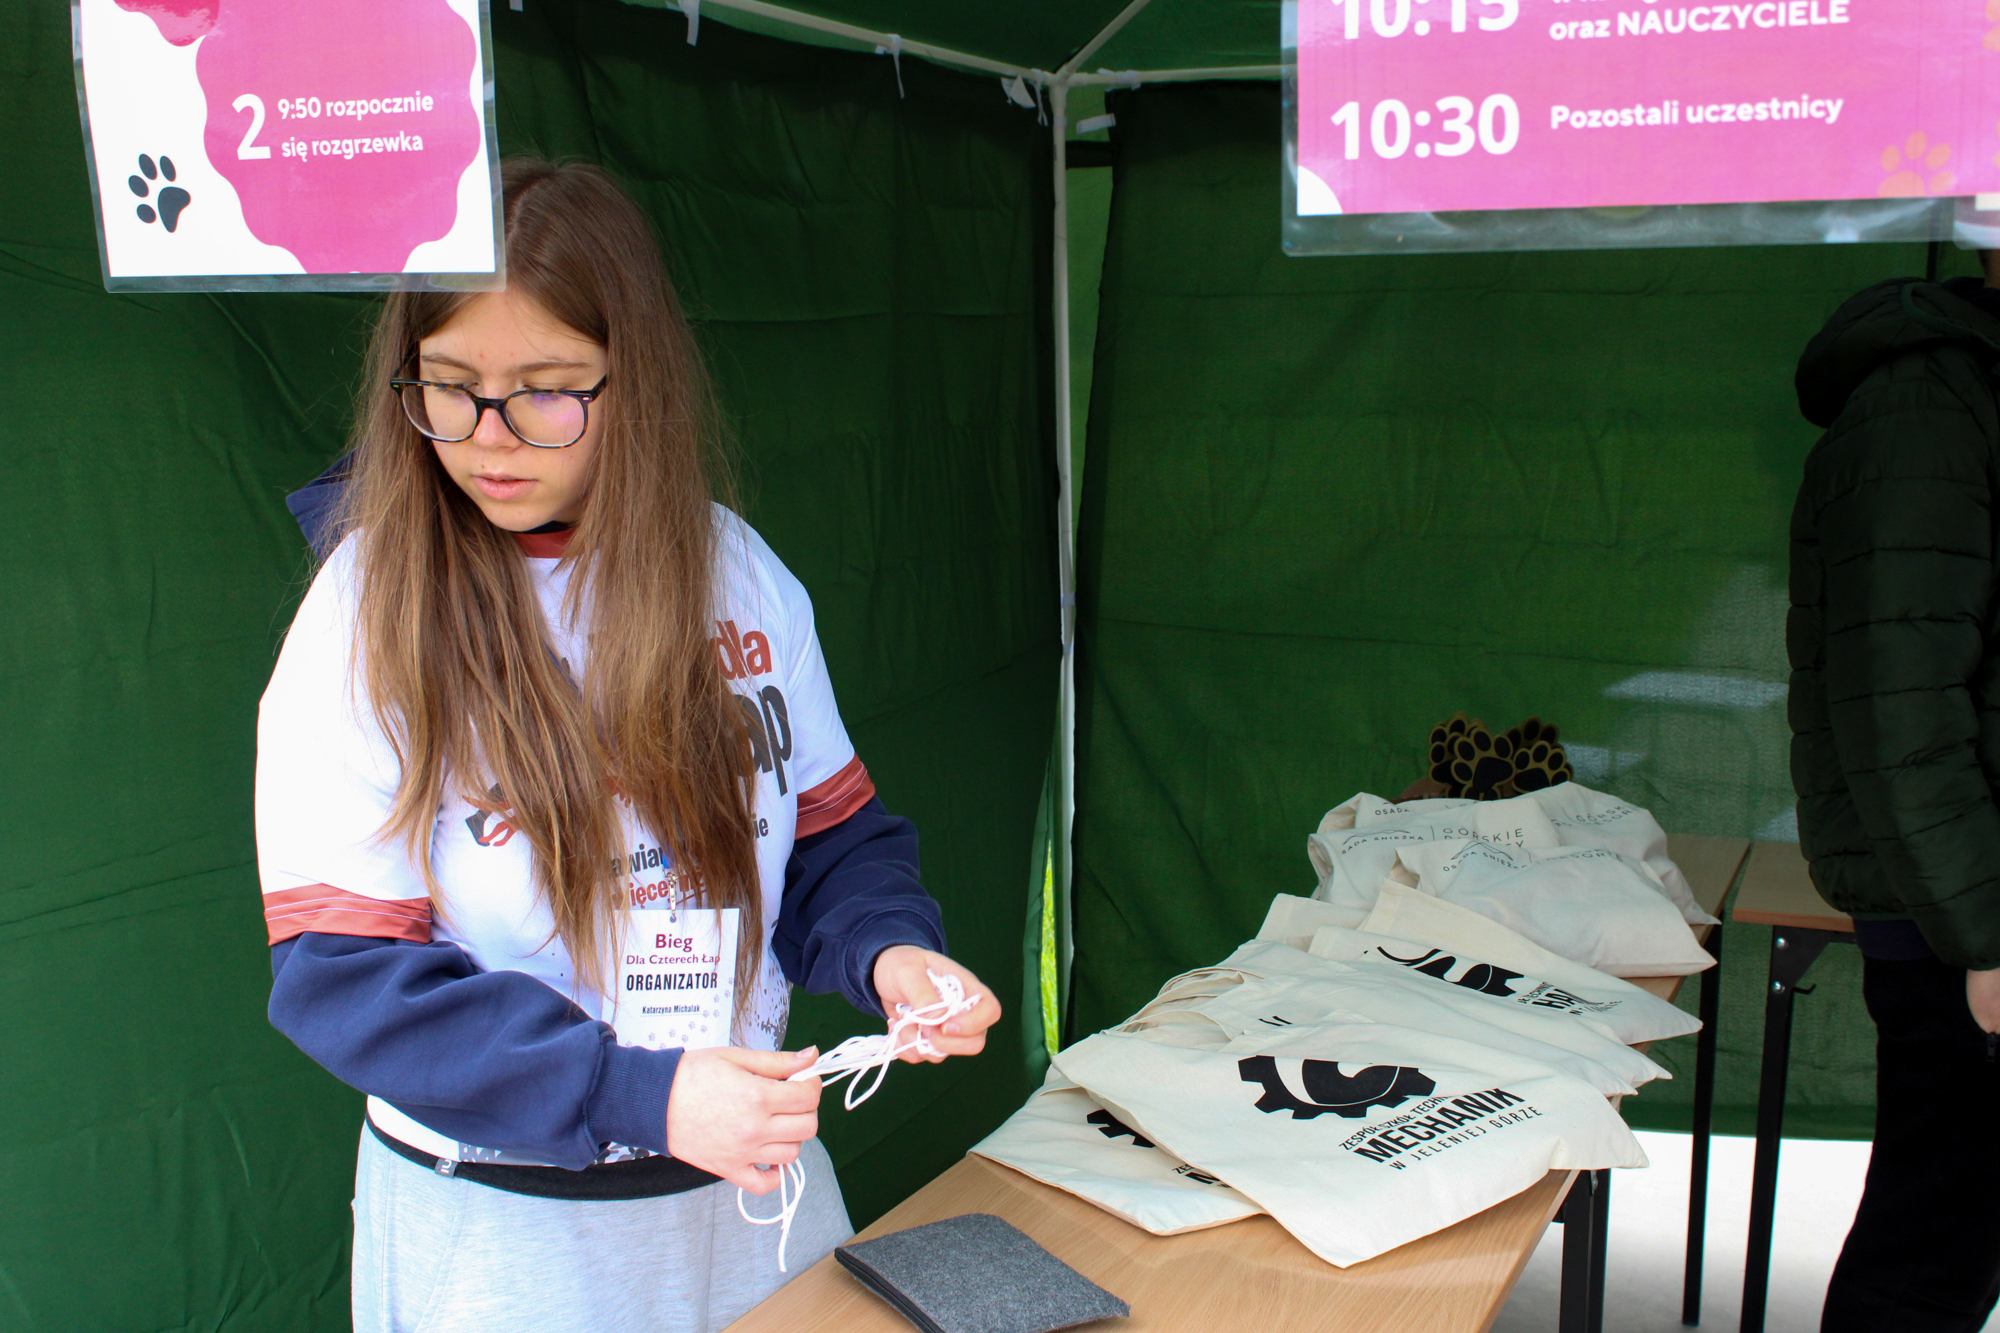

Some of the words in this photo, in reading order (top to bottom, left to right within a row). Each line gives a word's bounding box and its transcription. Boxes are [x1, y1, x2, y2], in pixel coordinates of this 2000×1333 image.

[1549, 19, 1610, 41] oraz
[1617, 0, 1850, 36] NAUCZYCIELE
[277, 97, 321, 120] 9:50
[326, 91, 434, 121] rozpocznie
[1549, 100, 1679, 130] Pozostali
[1686, 94, 1844, 125] uczestnicy
[232, 93, 271, 160] 2
[1330, 94, 1520, 160] 10:30
[281, 136, 308, 162] się
[311, 131, 424, 159] rozgrzewka
[709, 620, 772, 680] dla
[734, 685, 792, 797] ap
[626, 955, 645, 965] Dla
[649, 954, 698, 965] Czterech
[701, 954, 721, 966] Łap
[655, 933, 693, 952] Bieg
[626, 972, 718, 991] ORGANIZATOR
[642, 1005, 672, 1015] Katarzyna
[673, 1004, 700, 1014] Michalak
[1338, 1125, 1379, 1150] ZESPÓŁ
[1353, 1088, 1525, 1163] MECHANIK
[1389, 1160, 1407, 1171] W
[1410, 1125, 1487, 1161] JELENIEJ
[1489, 1106, 1543, 1129] GÓRZE
